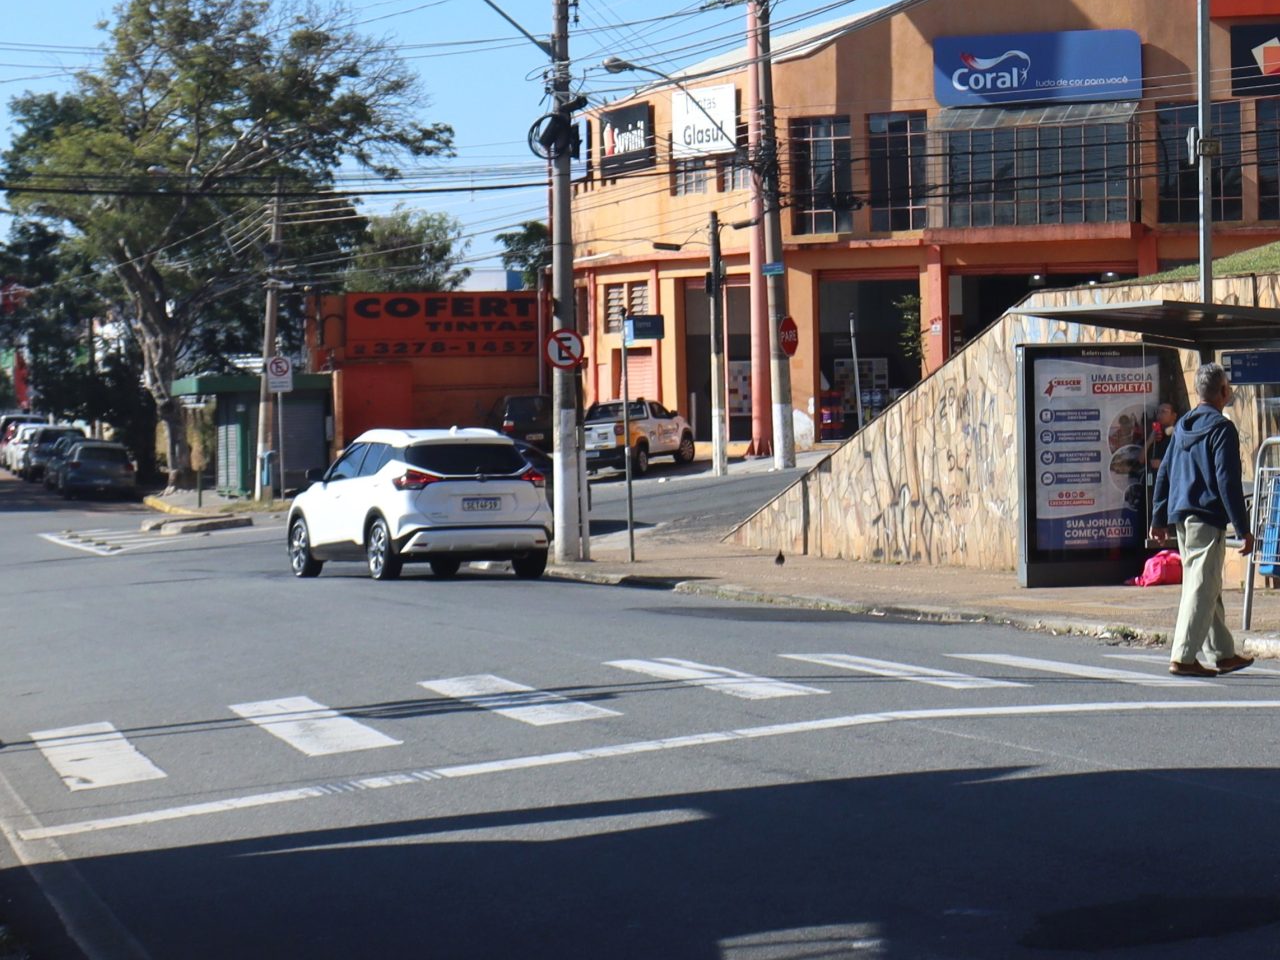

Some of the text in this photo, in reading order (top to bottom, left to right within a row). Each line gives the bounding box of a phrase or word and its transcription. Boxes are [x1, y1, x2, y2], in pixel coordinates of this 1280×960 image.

[951, 66, 1019, 91] Coral
[353, 297, 537, 319] COFERT
[425, 320, 536, 333] TINTAS
[781, 329, 797, 343] PARE
[1091, 372, 1153, 383] UMA ESCOLA
[1093, 383, 1151, 393] COMPLETA!
[1066, 518, 1132, 528] SUA JORNADA
[1064, 528, 1106, 539] COMEÇA
